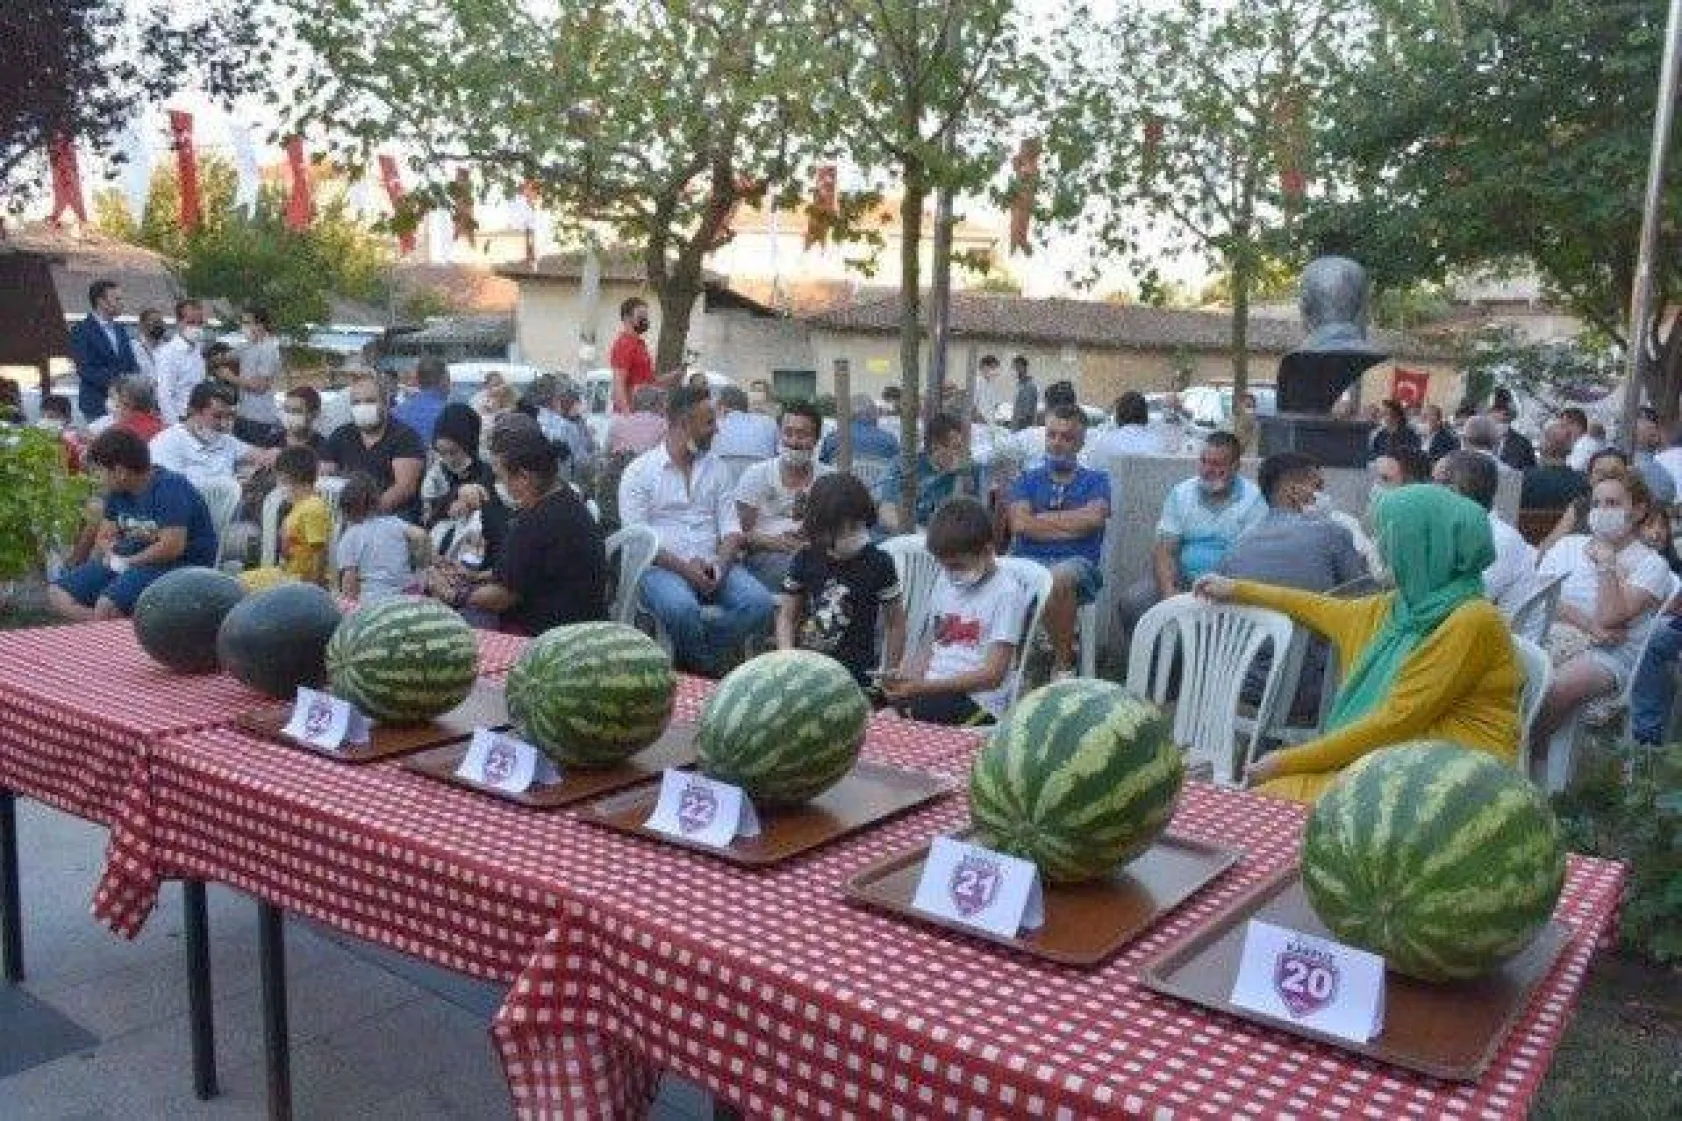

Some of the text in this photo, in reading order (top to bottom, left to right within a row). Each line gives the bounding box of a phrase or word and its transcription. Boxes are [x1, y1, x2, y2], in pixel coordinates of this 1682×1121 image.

[681, 796, 714, 821] 22
[957, 870, 996, 901] 21
[1281, 959, 1333, 998] 20
